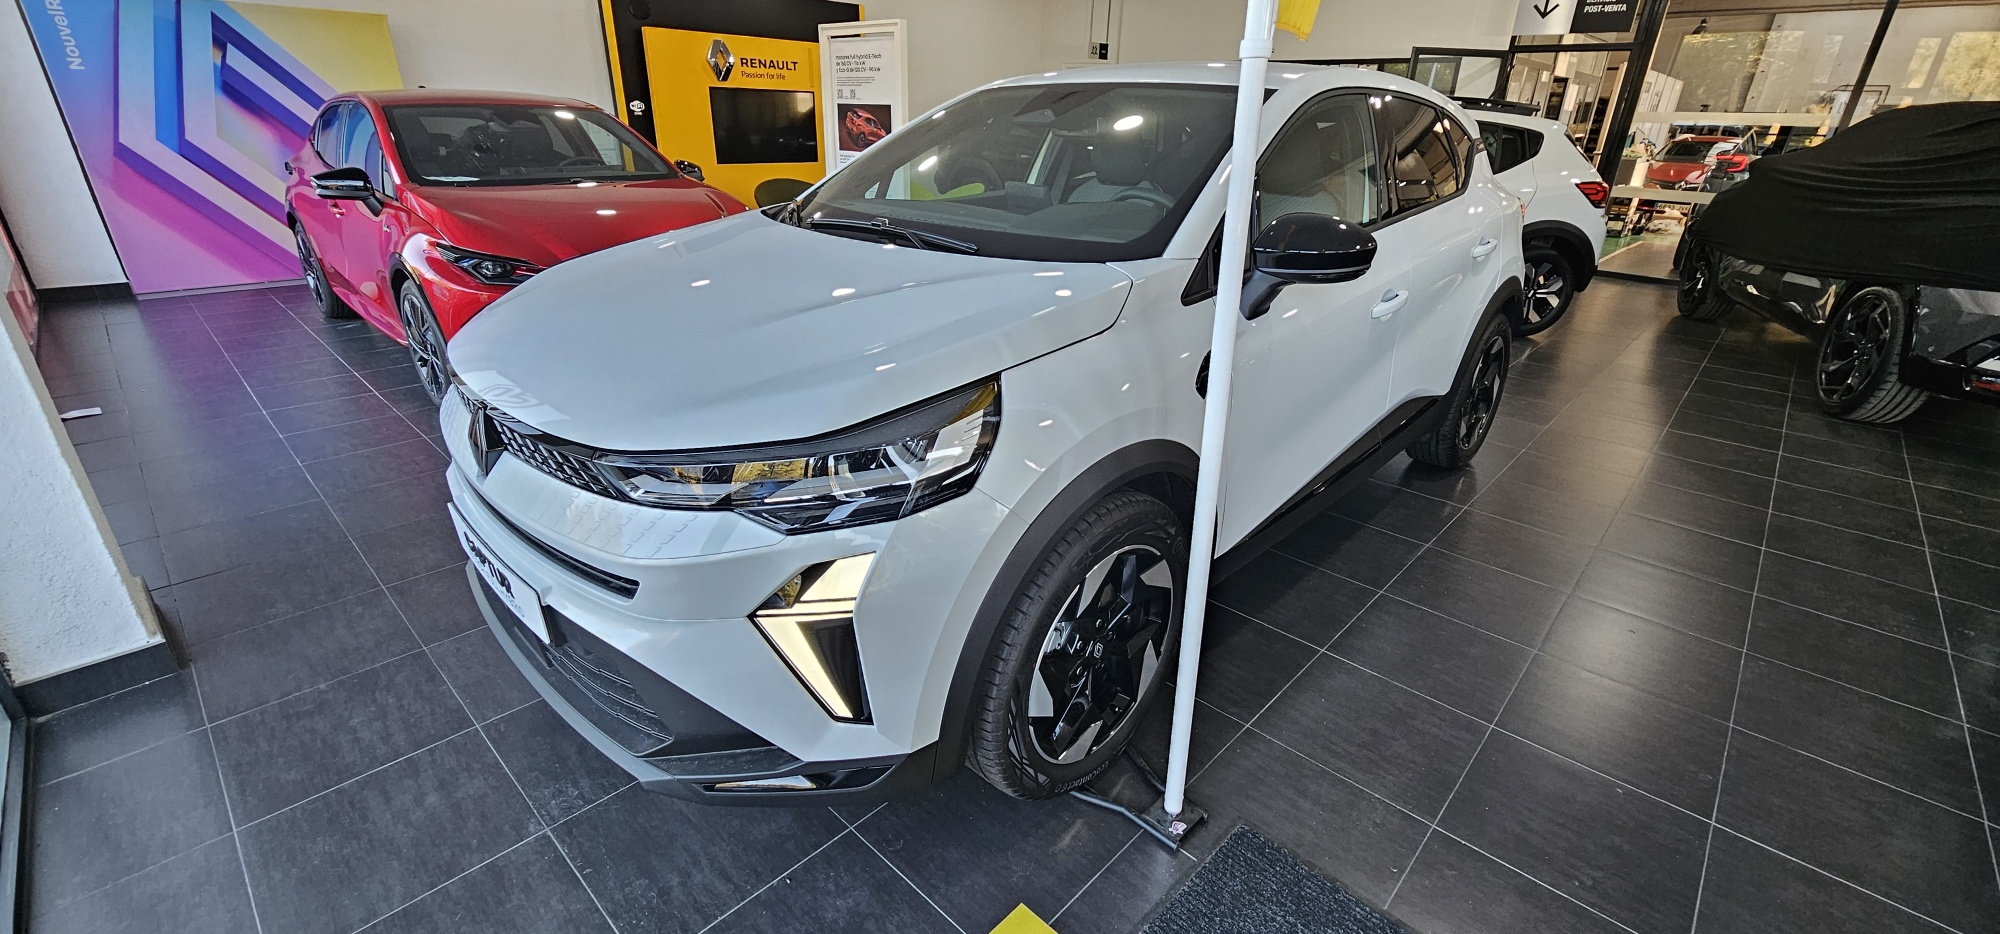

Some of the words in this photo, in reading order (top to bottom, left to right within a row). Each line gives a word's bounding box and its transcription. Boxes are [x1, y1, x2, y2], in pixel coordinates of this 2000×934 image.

[1584, 4, 1626, 12] POST-VENTA
[740, 58, 798, 71] RENAULT
[741, 71, 765, 79] Passion
